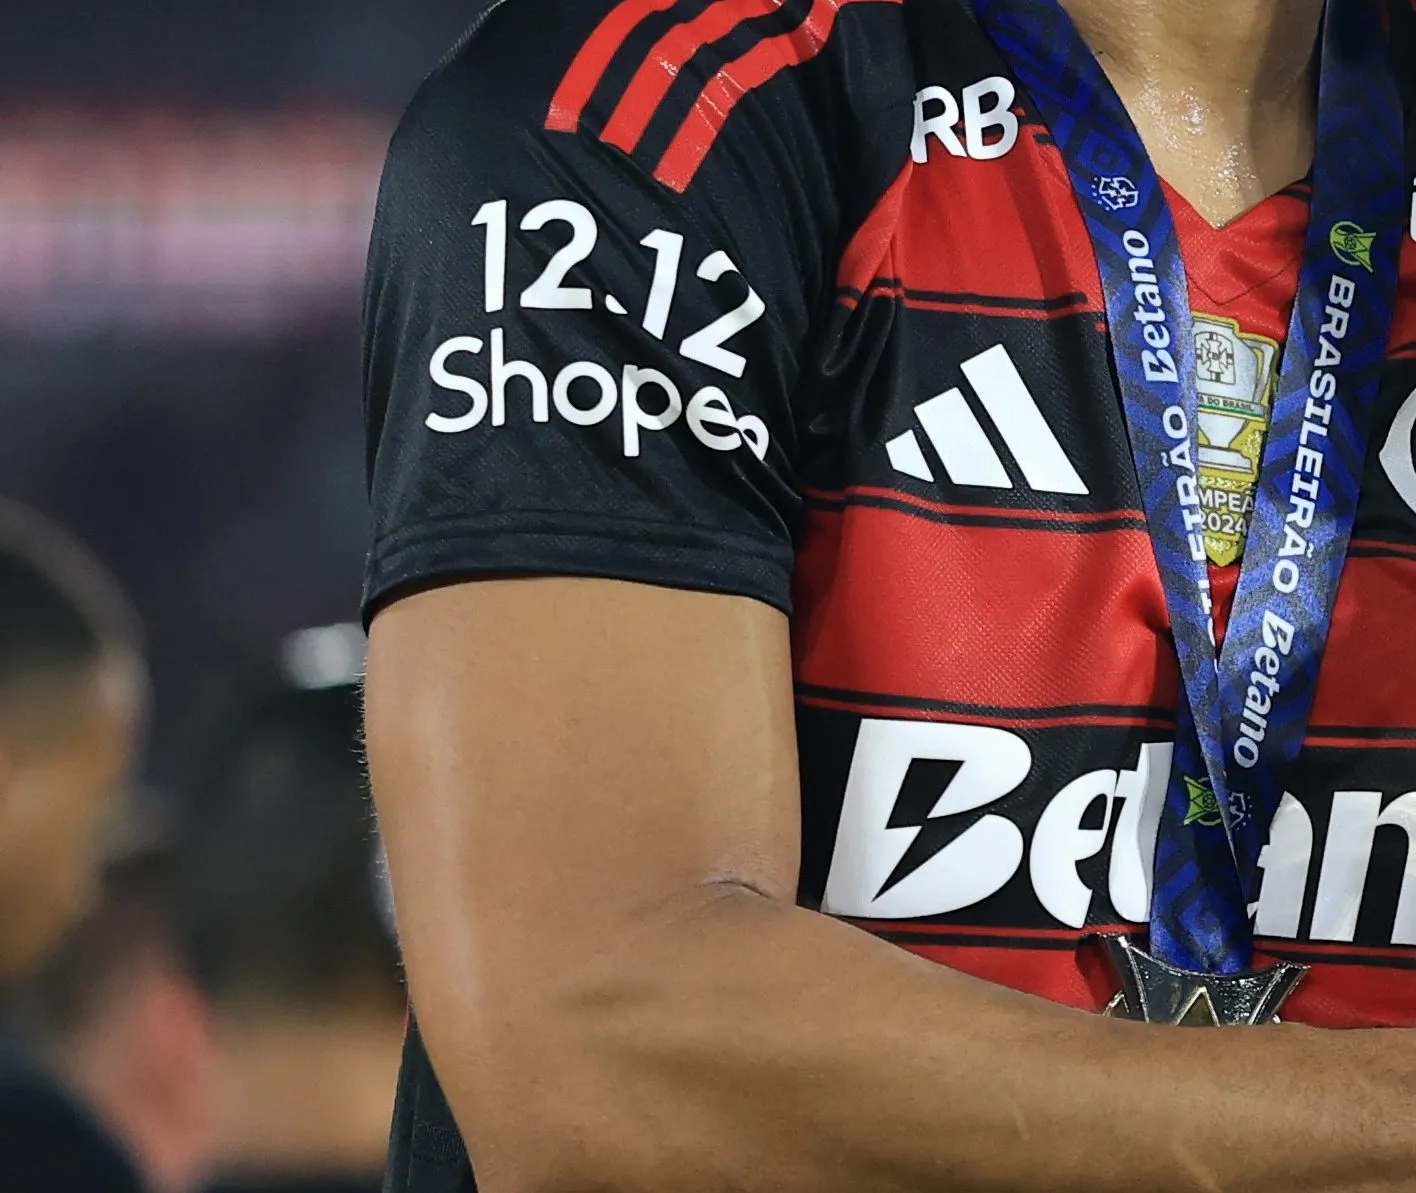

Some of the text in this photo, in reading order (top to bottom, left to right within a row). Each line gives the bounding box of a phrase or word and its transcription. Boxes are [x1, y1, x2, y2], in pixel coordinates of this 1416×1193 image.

[910, 76, 1018, 164] RB
[471, 199, 765, 378] 12.12
[1121, 228, 1179, 384] Betano
[1198, 487, 1254, 514] MPEÃ
[1232, 273, 1355, 769] BRASILEIRÃO Betano
